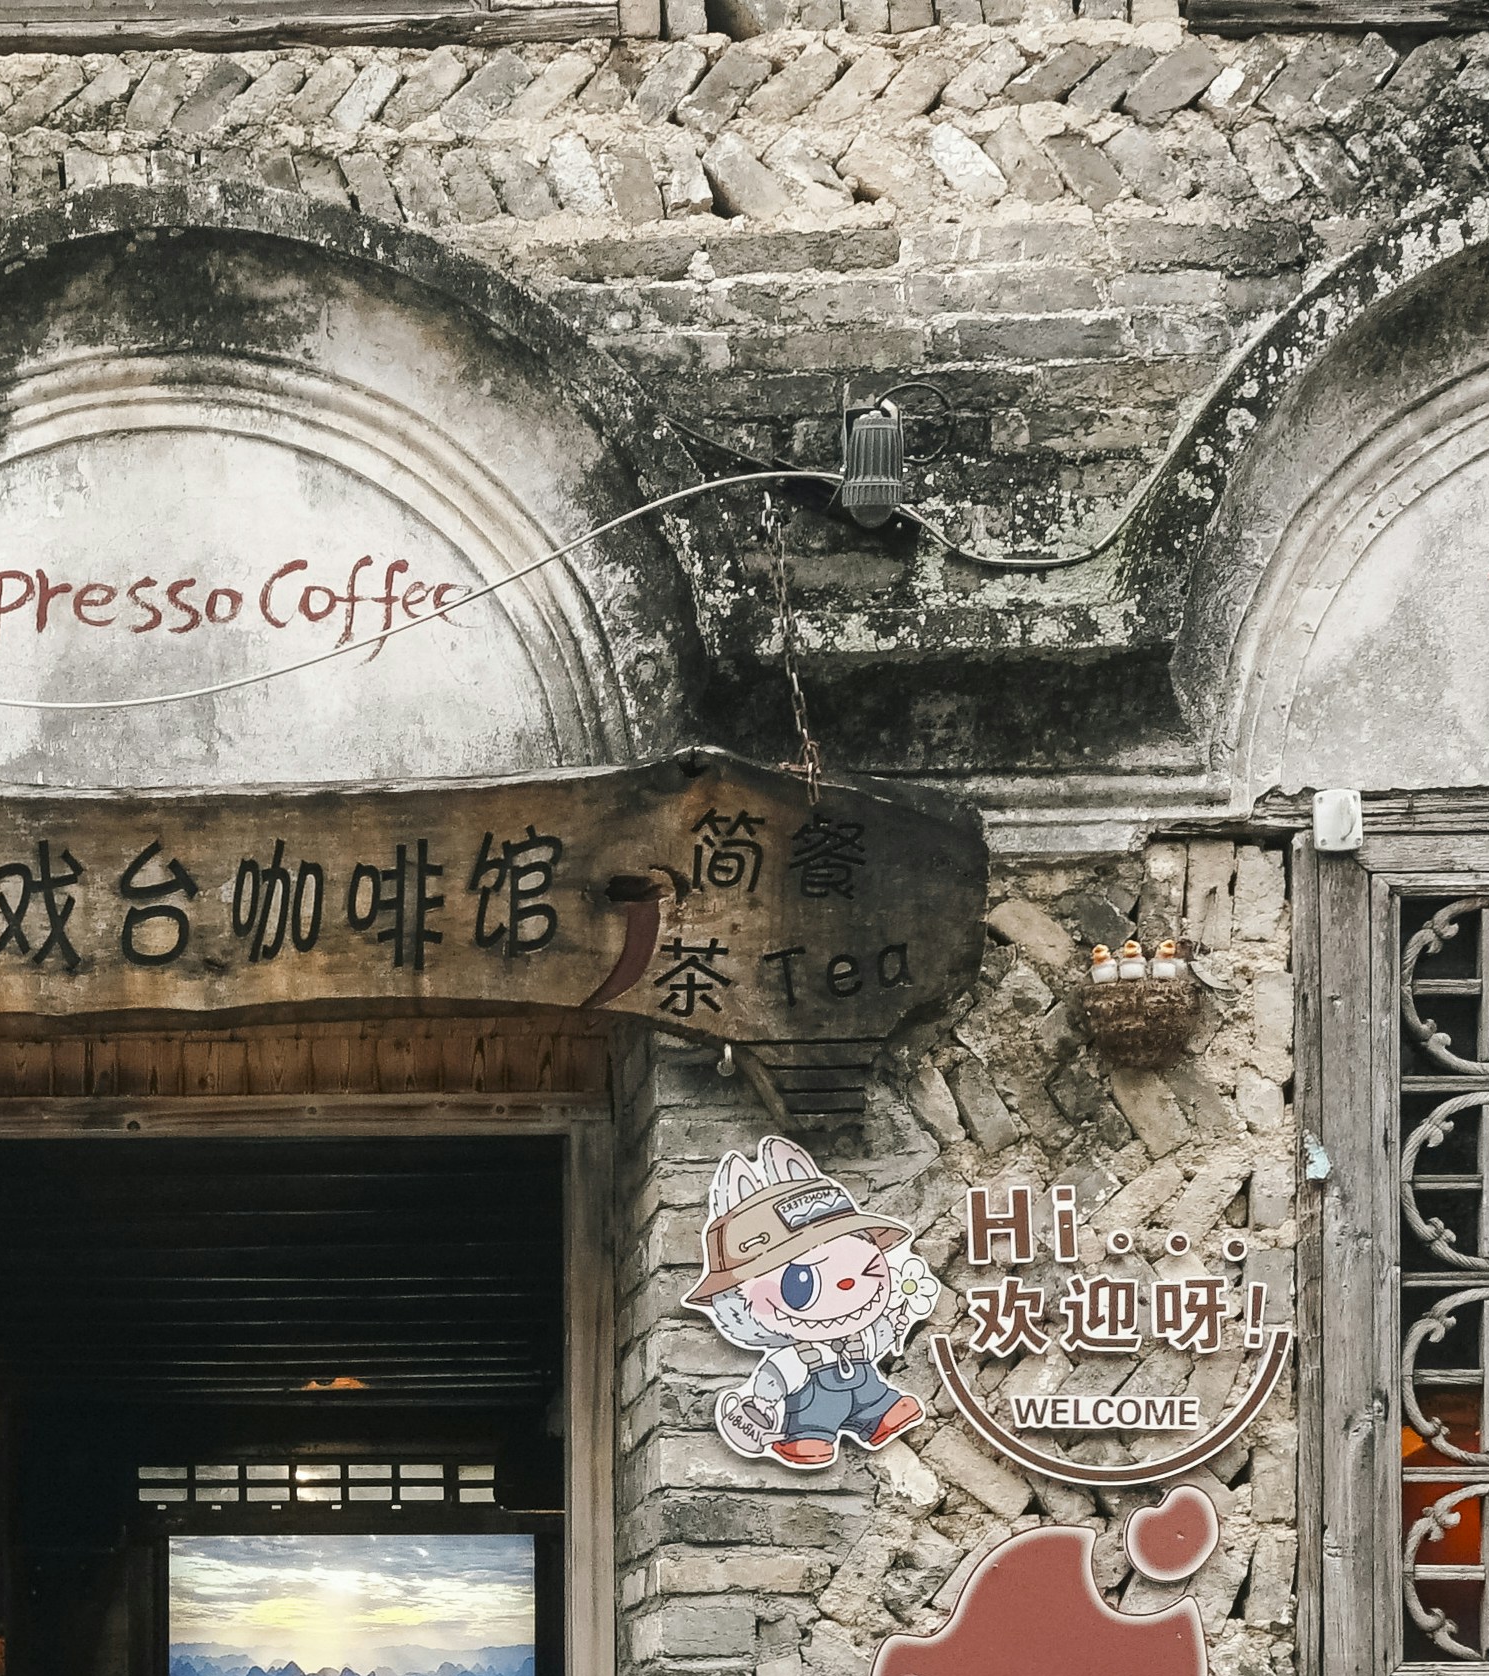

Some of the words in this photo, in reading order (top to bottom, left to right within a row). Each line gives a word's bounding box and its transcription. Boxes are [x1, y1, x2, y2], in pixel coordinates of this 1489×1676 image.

[261, 555, 480, 664] Coffee
[689, 806, 867, 901] 简餐
[653, 937, 733, 1018] 茶
[763, 941, 913, 1009] Tea
[1013, 1397, 1201, 1430] WELCOME
